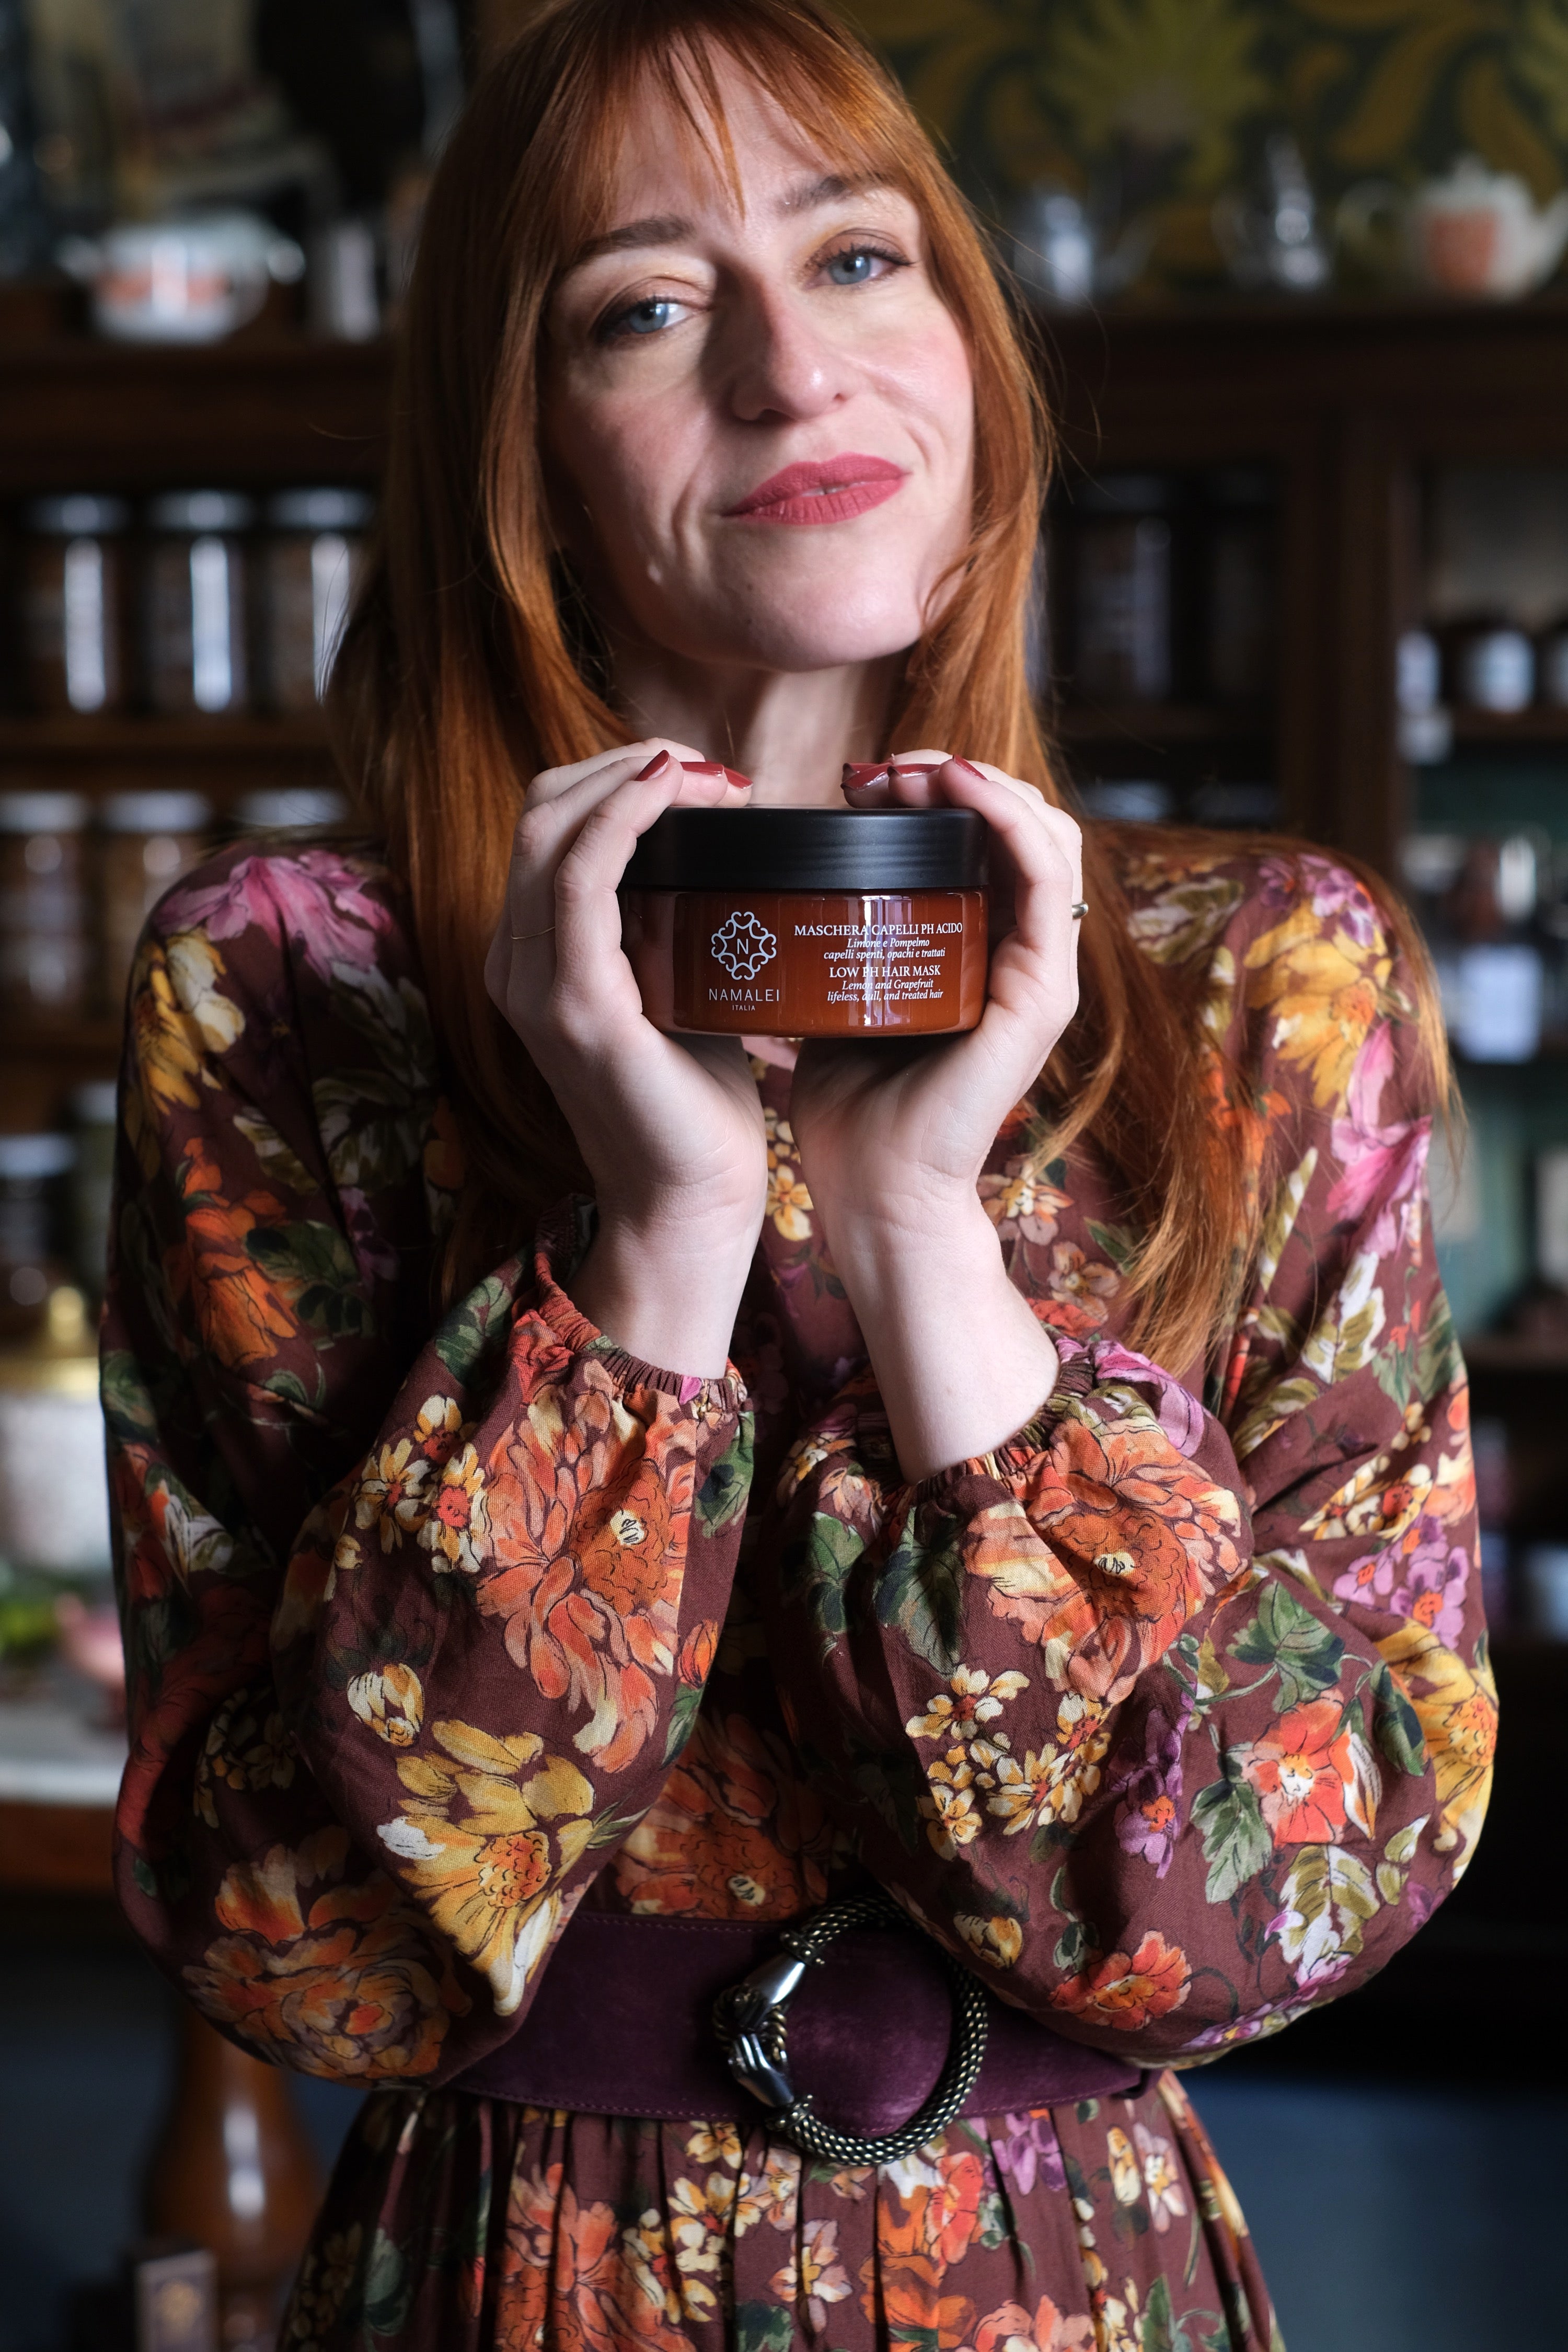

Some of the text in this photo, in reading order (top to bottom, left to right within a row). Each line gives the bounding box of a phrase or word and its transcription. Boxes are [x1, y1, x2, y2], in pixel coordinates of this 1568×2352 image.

[794, 923, 963, 936] MASCHERA CAPELLI PH ACIDO
[737, 938, 748, 954] N
[847, 938, 881, 948] Limone
[890, 937, 930, 950] Pompelmo
[824, 949, 855, 962] capelli
[856, 949, 885, 962] spenti,
[887, 949, 914, 961] opachi
[921, 947, 946, 958] trattati
[829, 965, 941, 977] LOW PH HAIR MASK
[841, 978, 933, 991] Lemon and Grapefruit
[709, 988, 779, 1001] NAMALEI
[827, 989, 944, 1004] lifeless, dull, and treated hair
